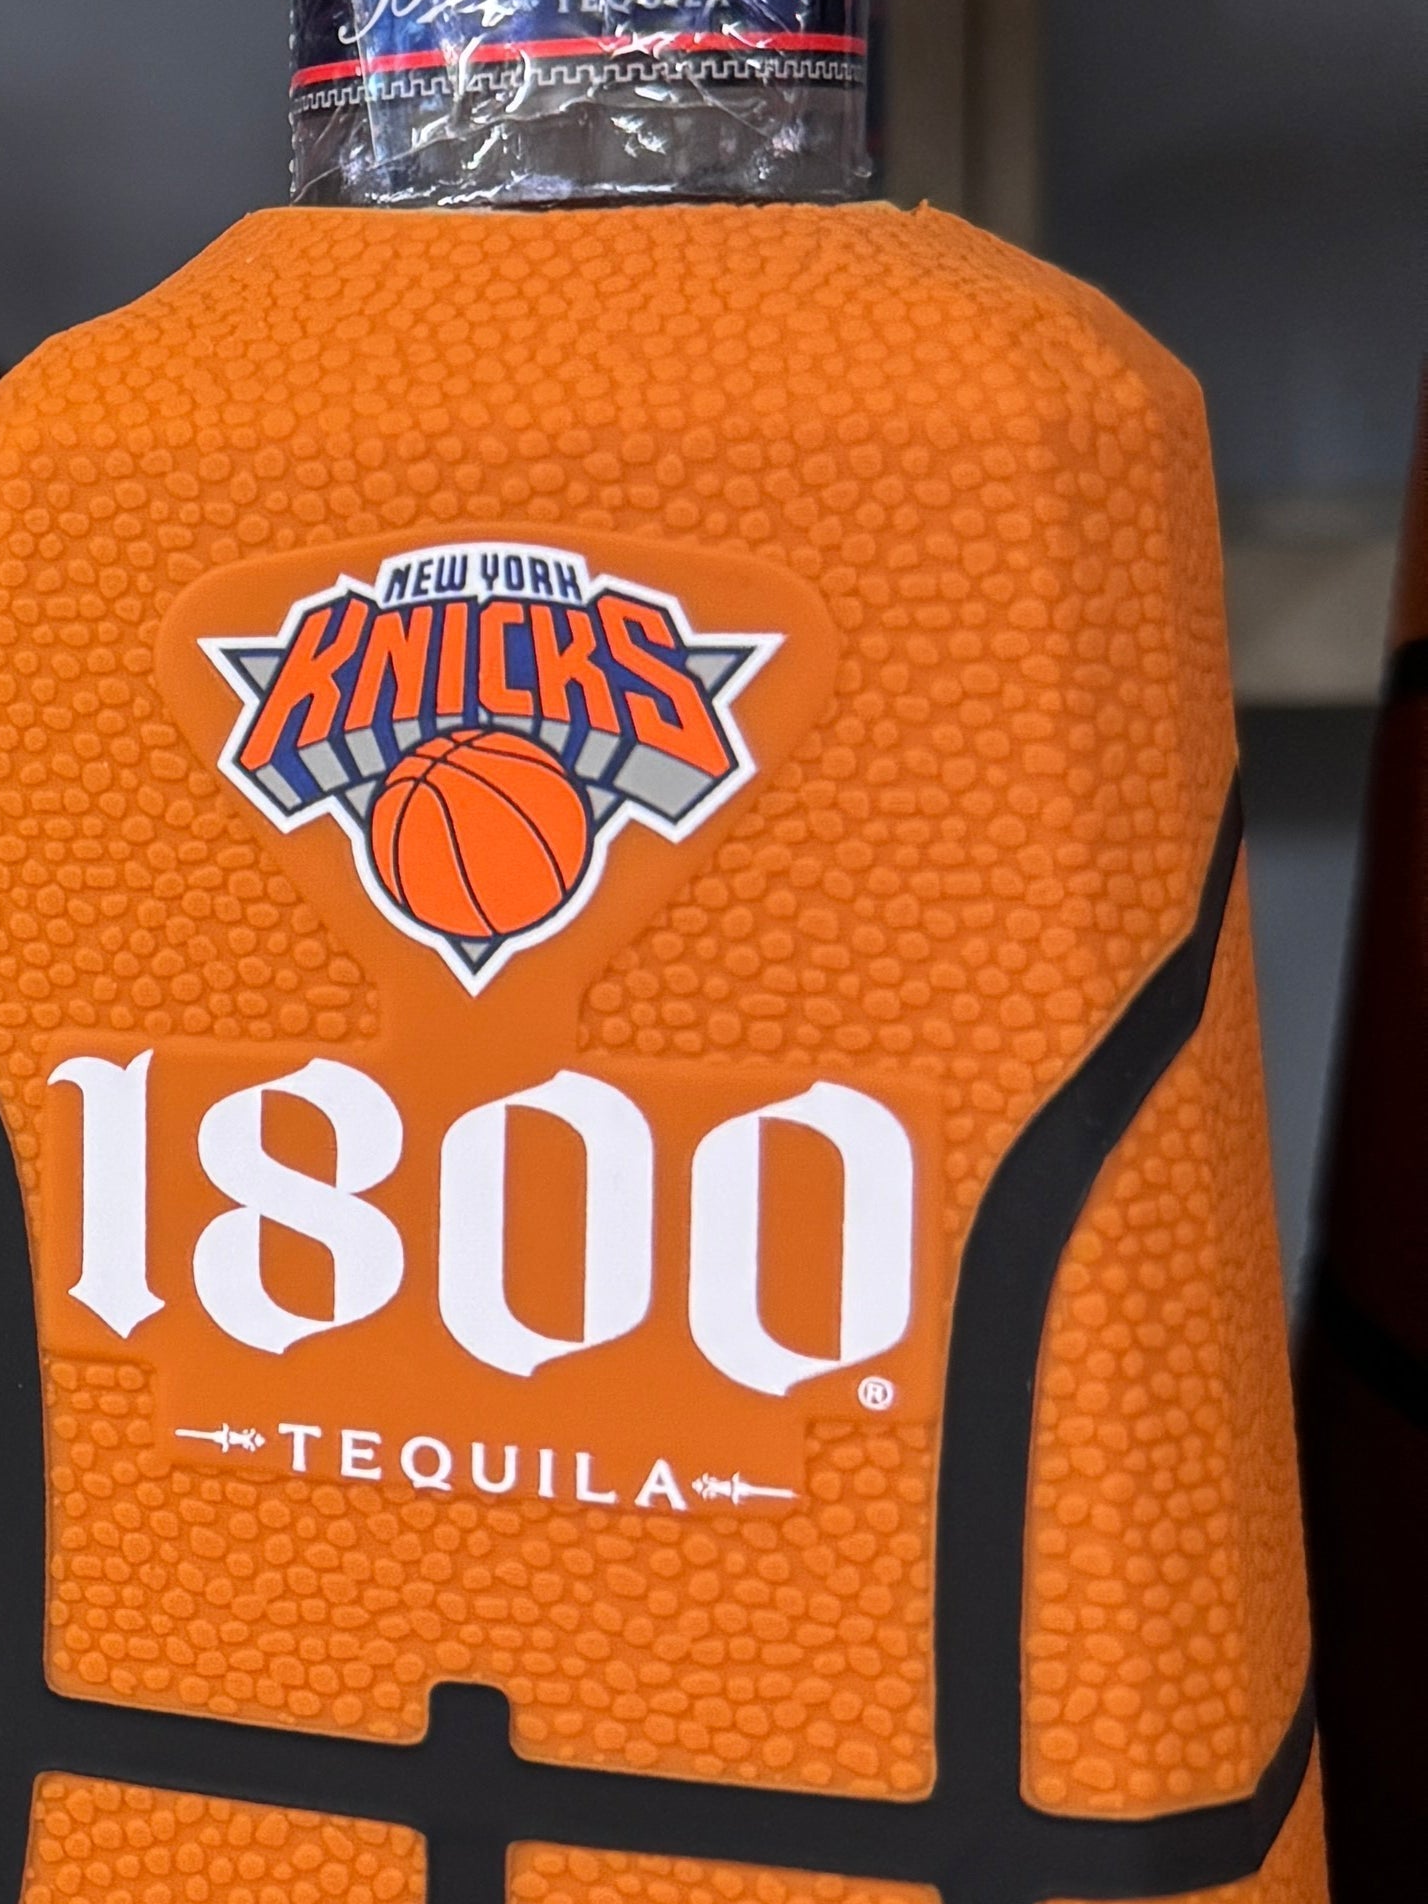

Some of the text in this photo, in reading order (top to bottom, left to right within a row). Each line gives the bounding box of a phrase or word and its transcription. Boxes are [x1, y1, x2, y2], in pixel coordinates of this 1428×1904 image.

[385, 553, 582, 602] NEW YORK
[239, 594, 732, 781] KNICKS
[47, 1049, 914, 1397] 1800
[277, 1422, 688, 1512] TEQUILA
